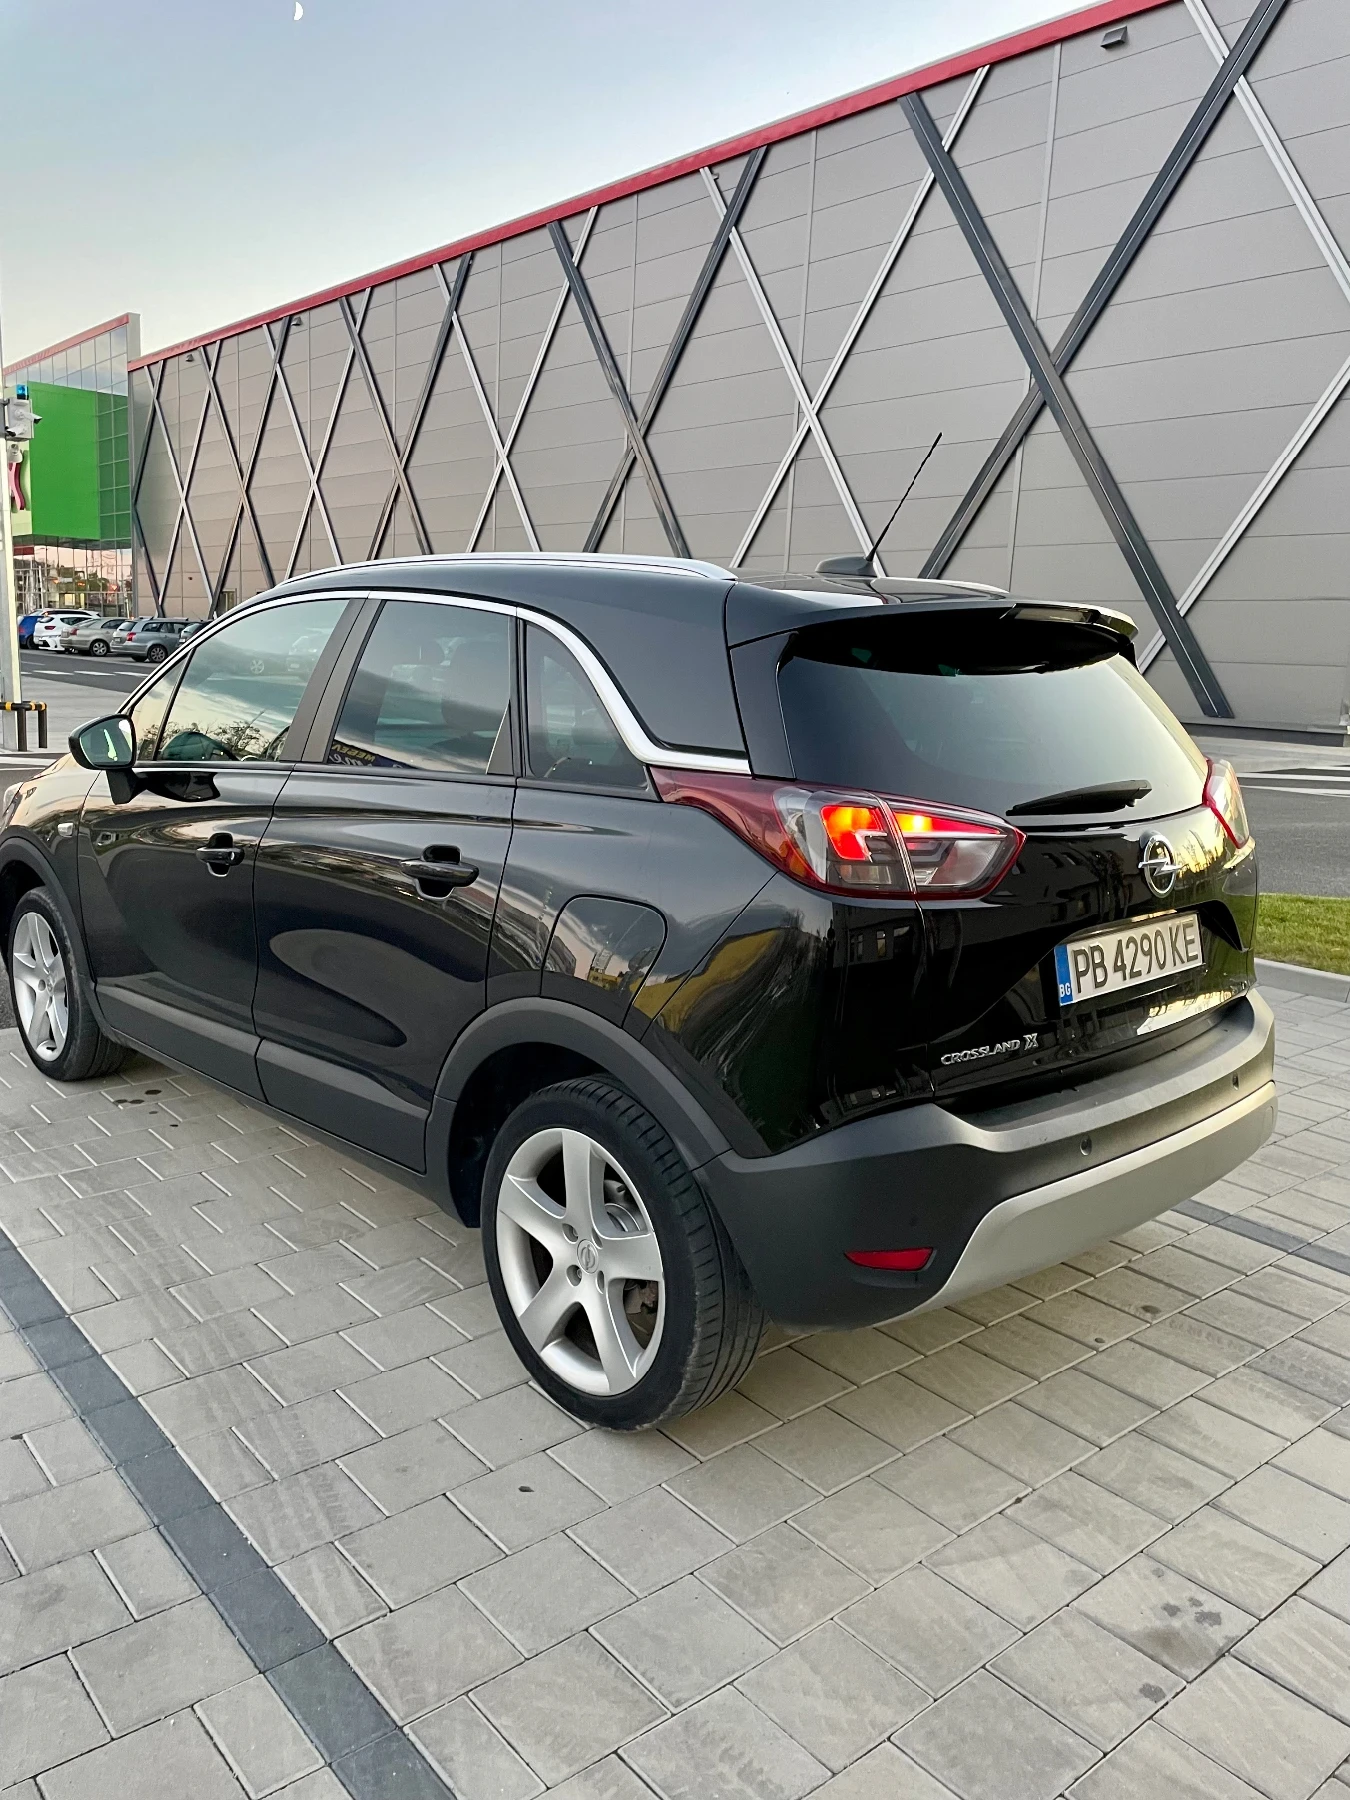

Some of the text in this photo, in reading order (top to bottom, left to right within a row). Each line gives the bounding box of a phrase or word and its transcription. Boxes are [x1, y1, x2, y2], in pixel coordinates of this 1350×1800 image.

[1071, 920, 1200, 994] PB 4290 KE
[1059, 983, 1072, 998] BG
[941, 1032, 1039, 1065] CROSSLAND X
